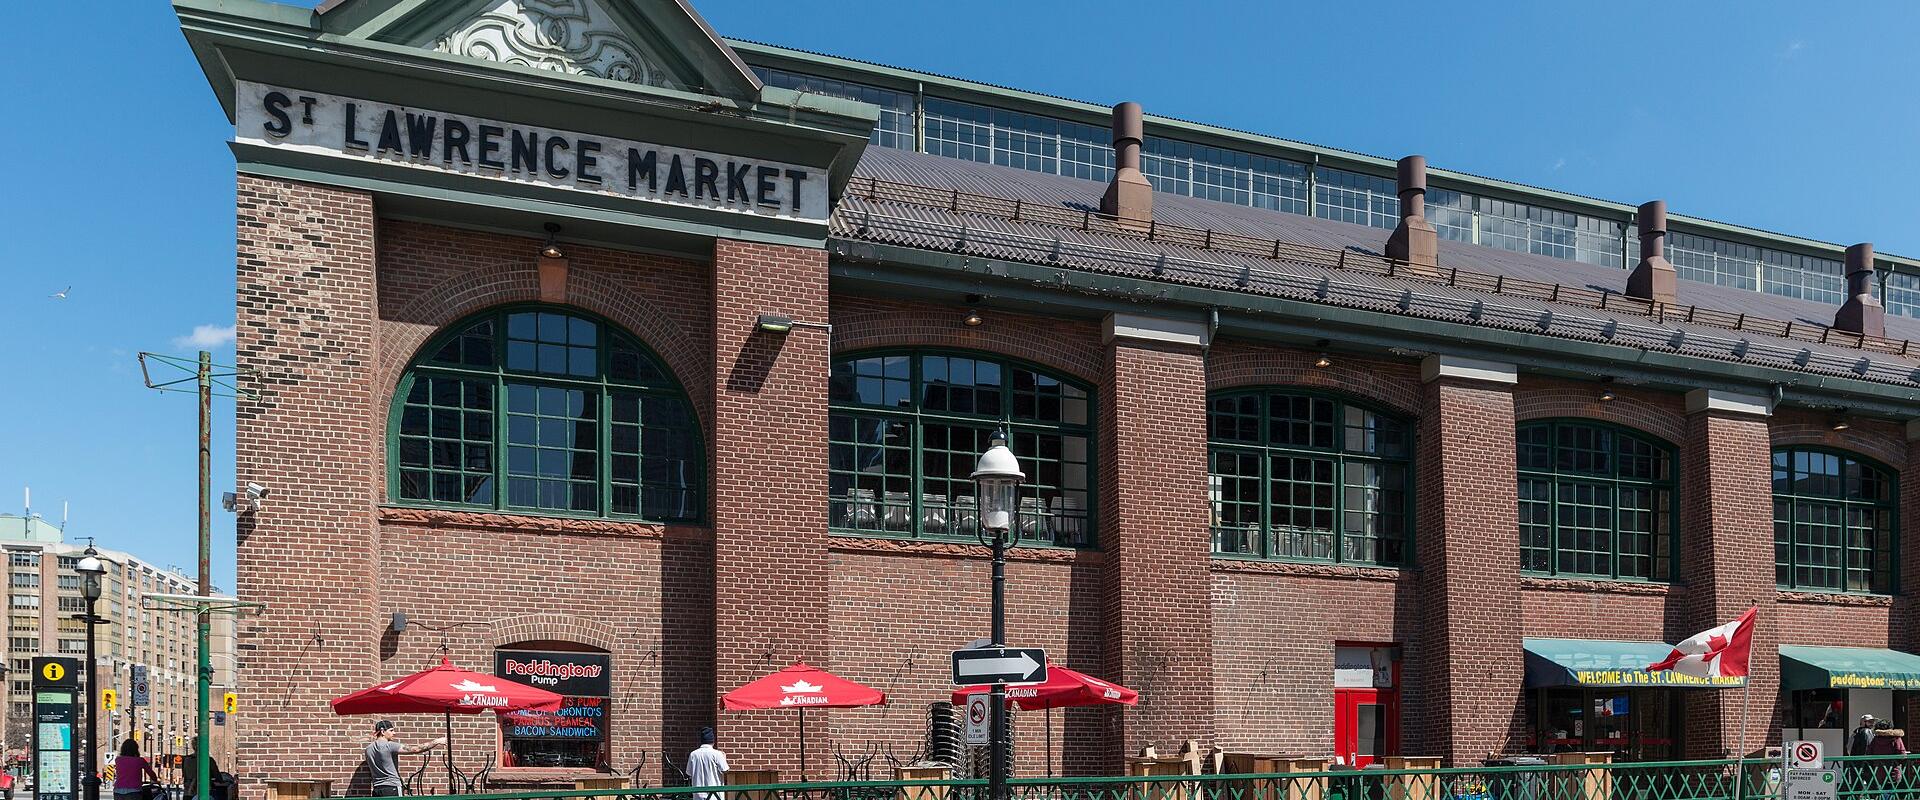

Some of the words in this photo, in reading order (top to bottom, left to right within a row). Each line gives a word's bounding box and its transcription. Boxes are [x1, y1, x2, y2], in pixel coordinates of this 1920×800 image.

[344, 102, 602, 184] LAWRENCE
[627, 147, 808, 212] MARKET
[505, 659, 602, 680] Paddington's
[531, 675, 558, 686] Pump
[1577, 671, 1620, 684] WELCOME
[1622, 671, 1632, 684] to
[1633, 670, 1649, 684] The
[1888, 678, 1905, 687] Home
[1906, 678, 1914, 686] of
[1008, 688, 1038, 698] CANADIAN
[472, 695, 508, 707] CANADIAN
[577, 697, 602, 707] PUMP
[792, 696, 828, 705] CANADIAN
[513, 716, 550, 726] FAMOUS
[555, 716, 595, 727] PEAMEAL
[514, 726, 546, 736] BACON
[549, 727, 597, 737] SANDWICH
